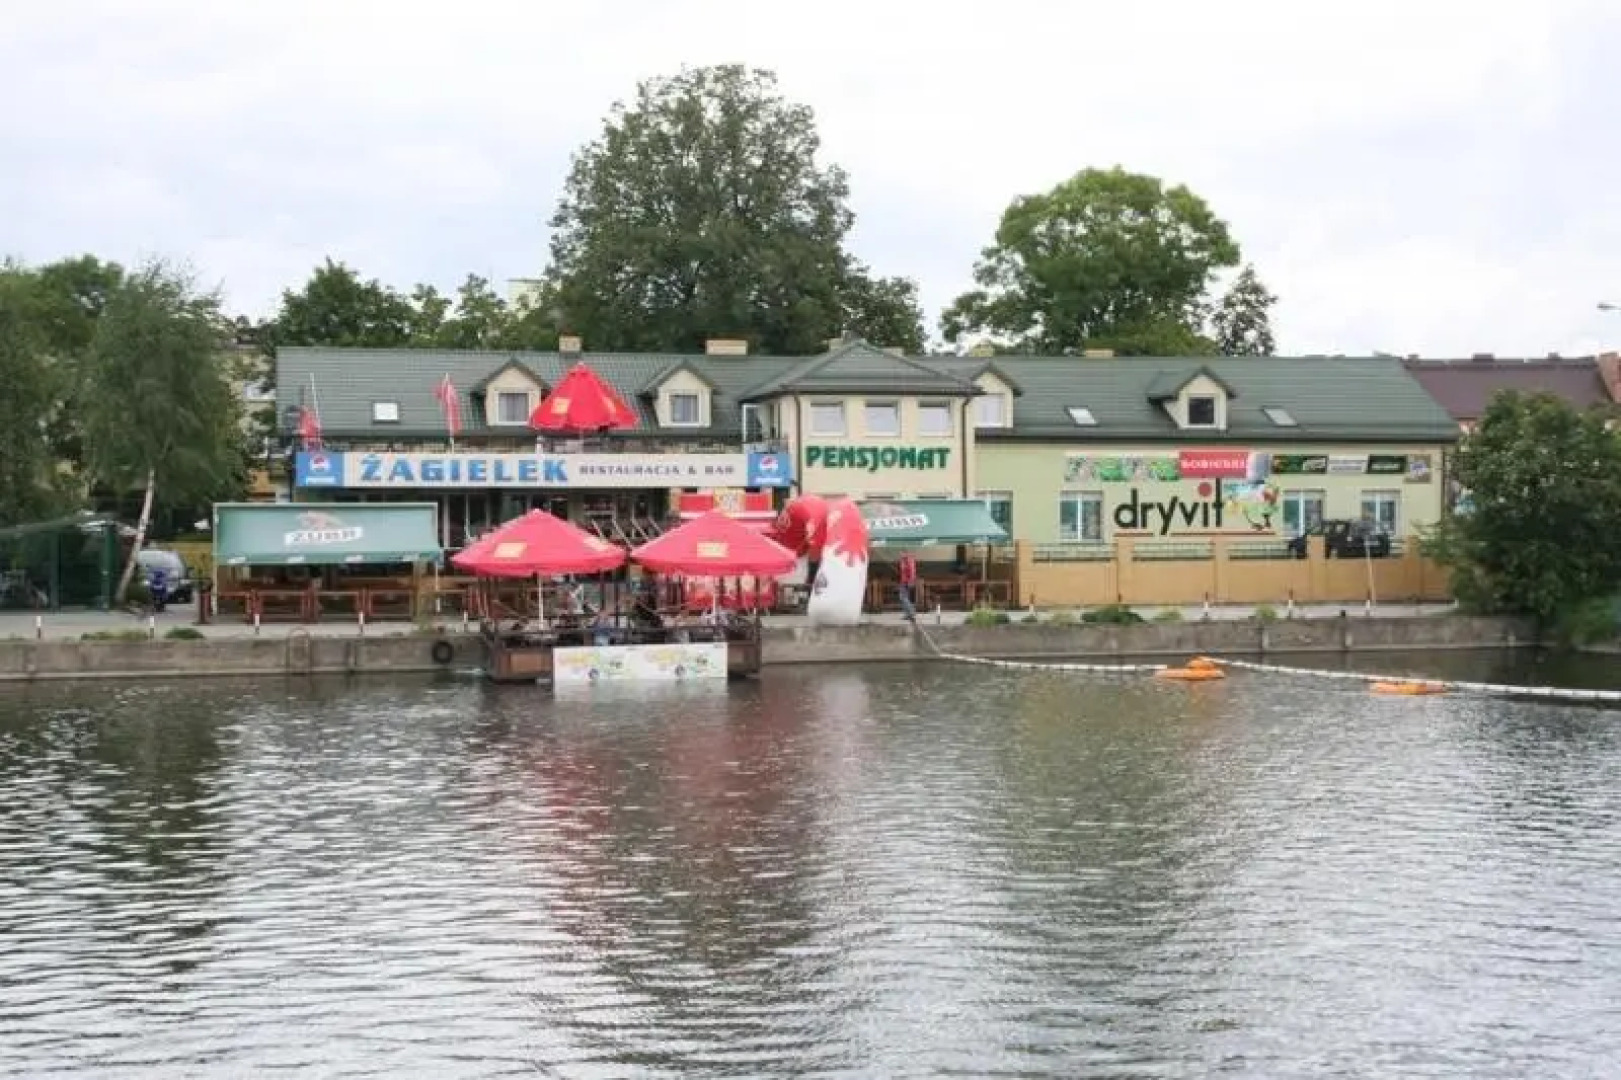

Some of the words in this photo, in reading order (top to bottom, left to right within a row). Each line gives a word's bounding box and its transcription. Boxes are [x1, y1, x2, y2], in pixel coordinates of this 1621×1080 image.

[360, 453, 568, 482] ŻAGIELEK
[579, 464, 680, 475] RESTAURACJA
[705, 464, 735, 475] BAR
[805, 445, 950, 472] PENSJONAT
[1114, 477, 1226, 535] dryvit
